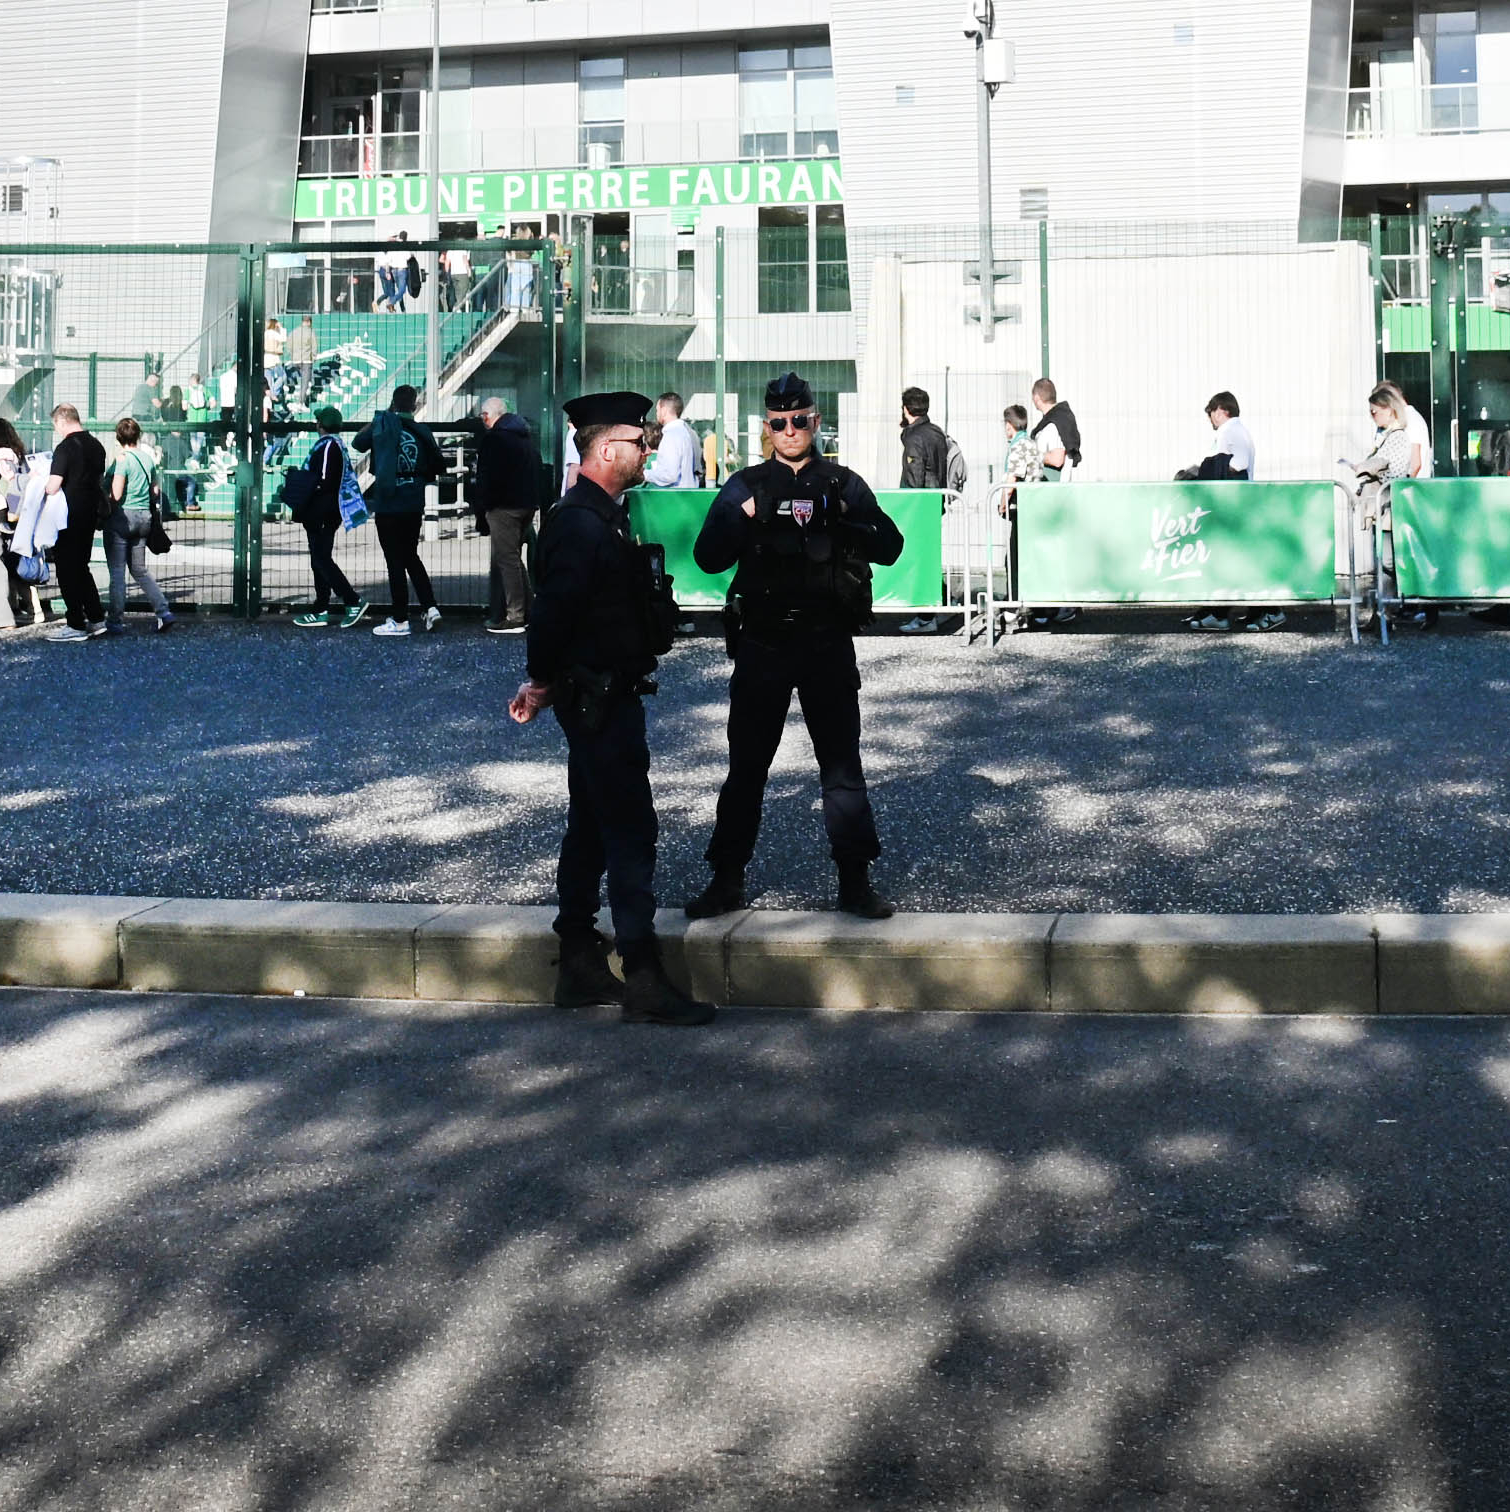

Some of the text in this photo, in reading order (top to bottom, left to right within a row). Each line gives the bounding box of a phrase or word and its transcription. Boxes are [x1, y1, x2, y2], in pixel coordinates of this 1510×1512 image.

[309, 177, 485, 217] TRIBUNE
[504, 171, 651, 211] PIERRE
[1151, 504, 1211, 543] Vert
